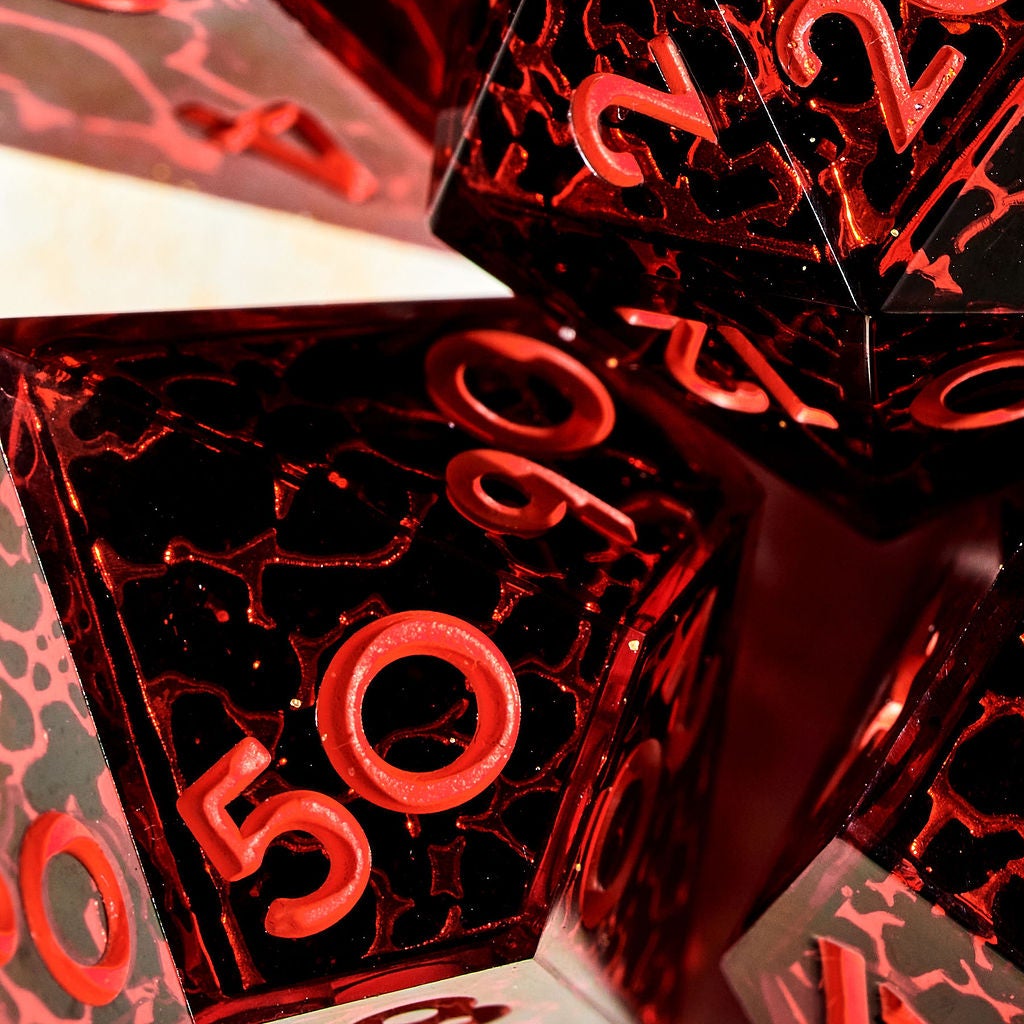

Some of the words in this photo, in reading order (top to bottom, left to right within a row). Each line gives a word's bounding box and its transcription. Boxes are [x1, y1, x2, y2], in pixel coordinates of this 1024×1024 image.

[174, 100, 379, 204] 4
[570, 32, 718, 188] 2
[424, 328, 637, 546] 90
[614, 305, 839, 431] 12
[176, 610, 521, 939] 50
[0, 810, 134, 1007] 0
